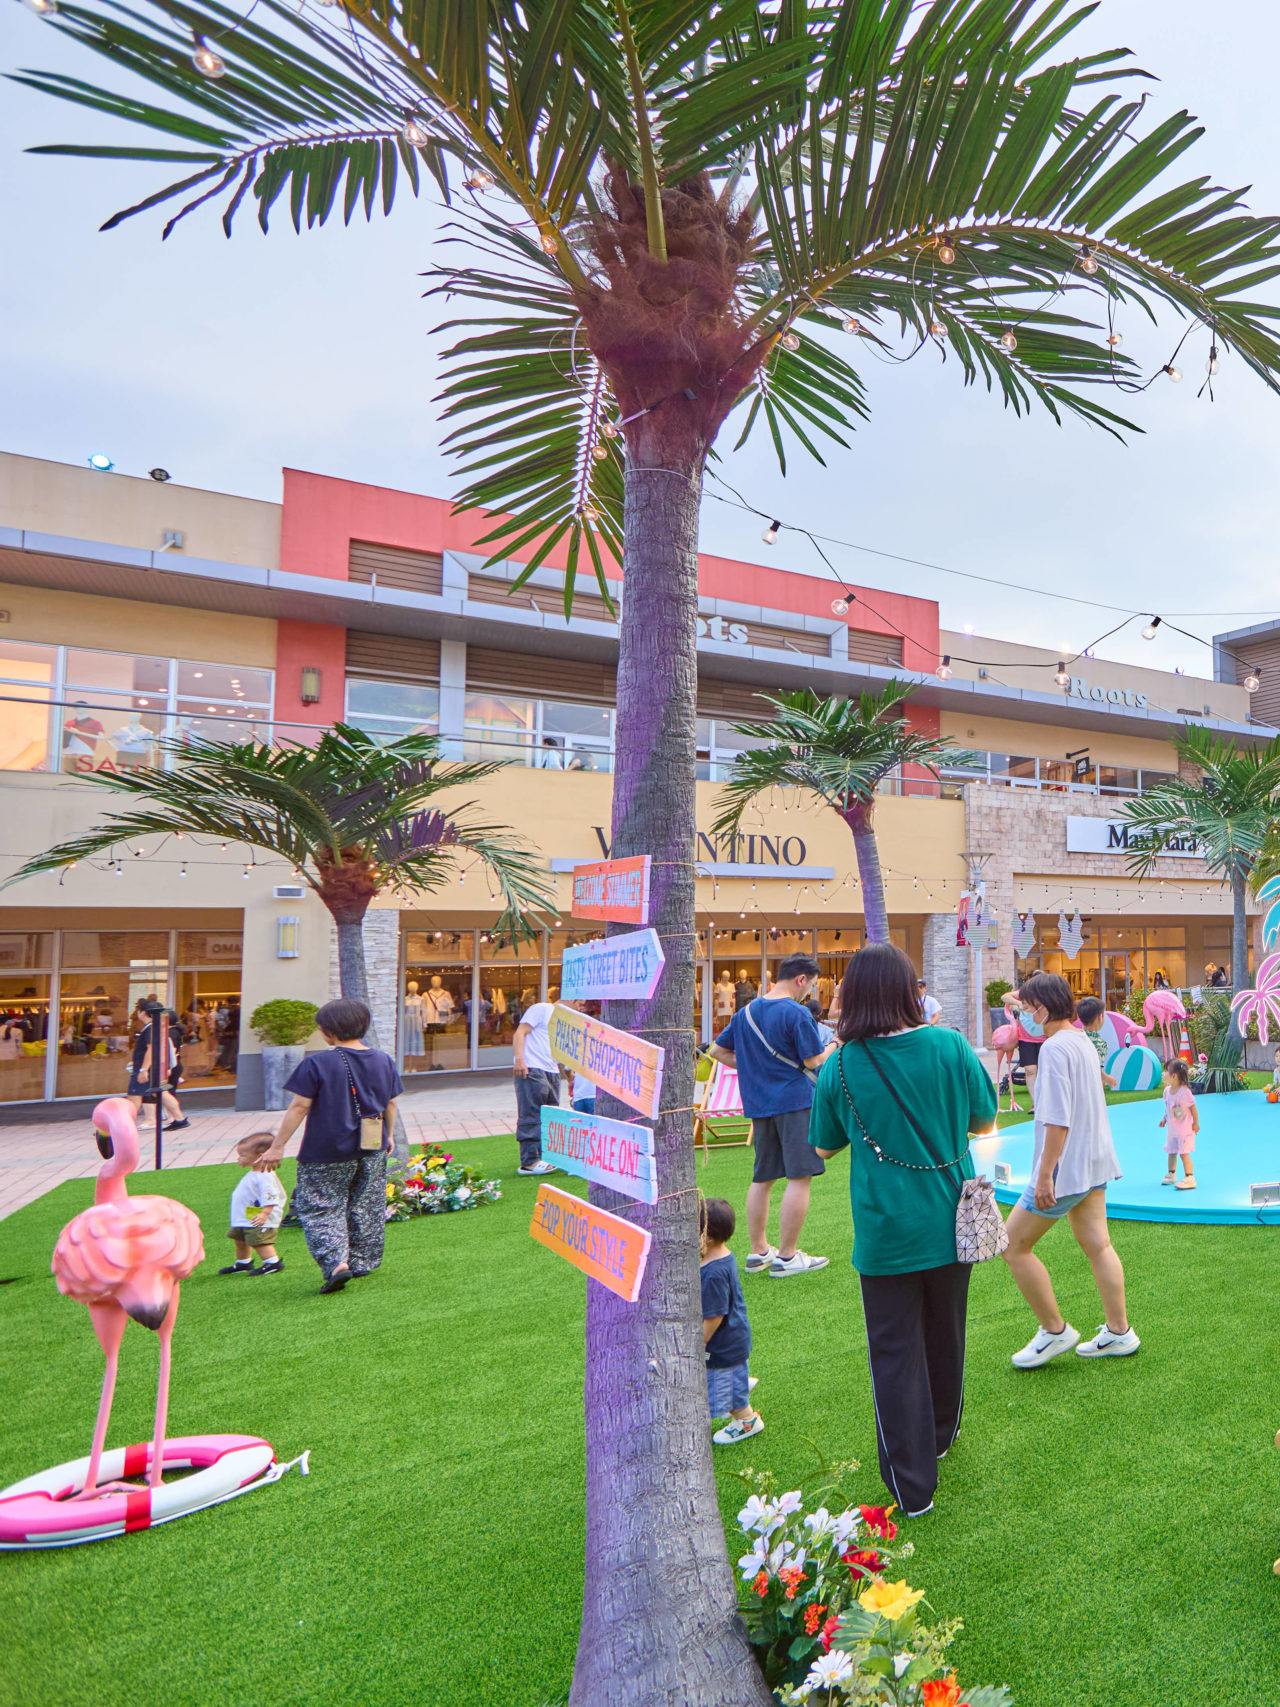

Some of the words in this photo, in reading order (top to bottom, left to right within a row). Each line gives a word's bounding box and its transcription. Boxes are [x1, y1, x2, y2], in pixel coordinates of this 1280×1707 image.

[1069, 676, 1148, 709] Roots
[591, 826, 806, 867] VNTINO
[574, 873, 606, 906] WELCOME
[606, 870, 641, 908] SUMMER
[565, 956, 586, 989] TASTY
[587, 950, 618, 986] STREET
[619, 945, 649, 985] BITES
[554, 1018, 581, 1061] PHASE
[588, 1036, 642, 1097] SHOPPING
[547, 1121, 567, 1156] SUN
[618, 1138, 640, 1182] ON!
[541, 1199, 560, 1237] POP
[562, 1208, 588, 1256] YOUR
[589, 1225, 627, 1280] STYLE
